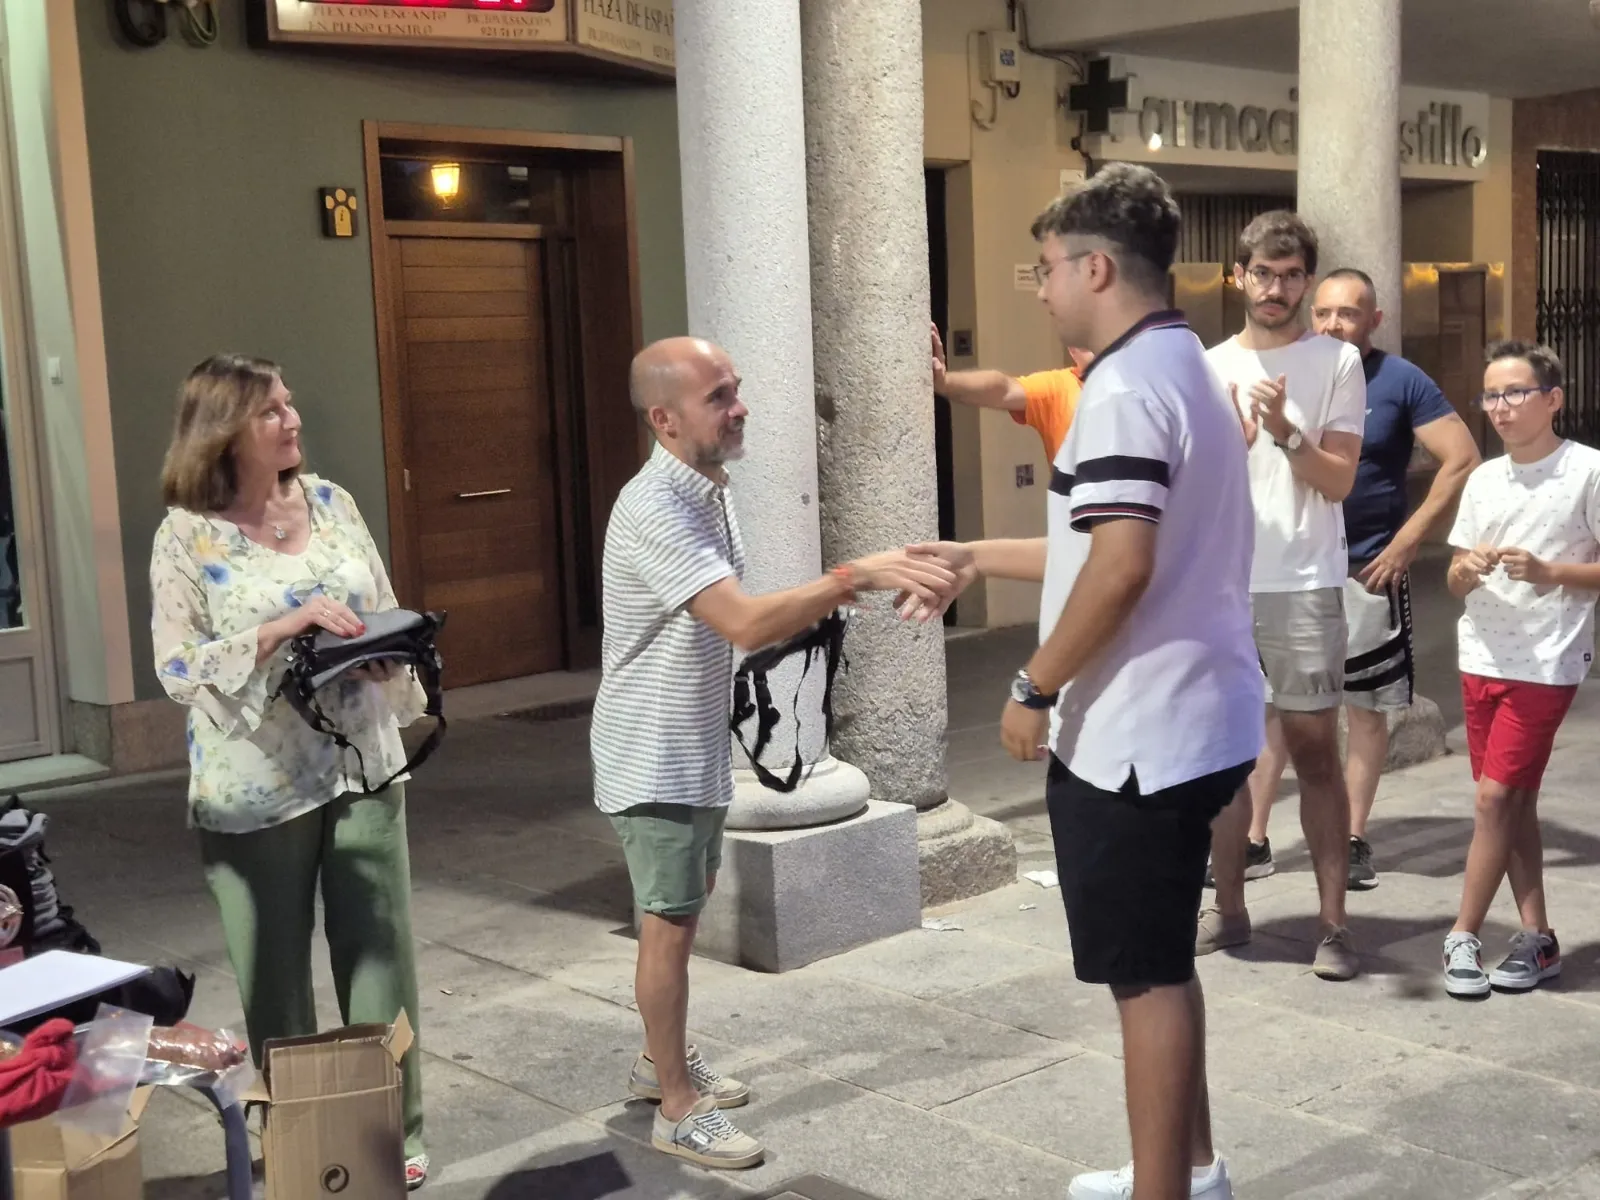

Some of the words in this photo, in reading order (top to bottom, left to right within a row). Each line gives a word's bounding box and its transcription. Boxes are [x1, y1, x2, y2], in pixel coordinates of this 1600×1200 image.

[626, 0, 641, 28] DE
[1138, 86, 1298, 155] armaci
[1399, 101, 1488, 169] stillo
